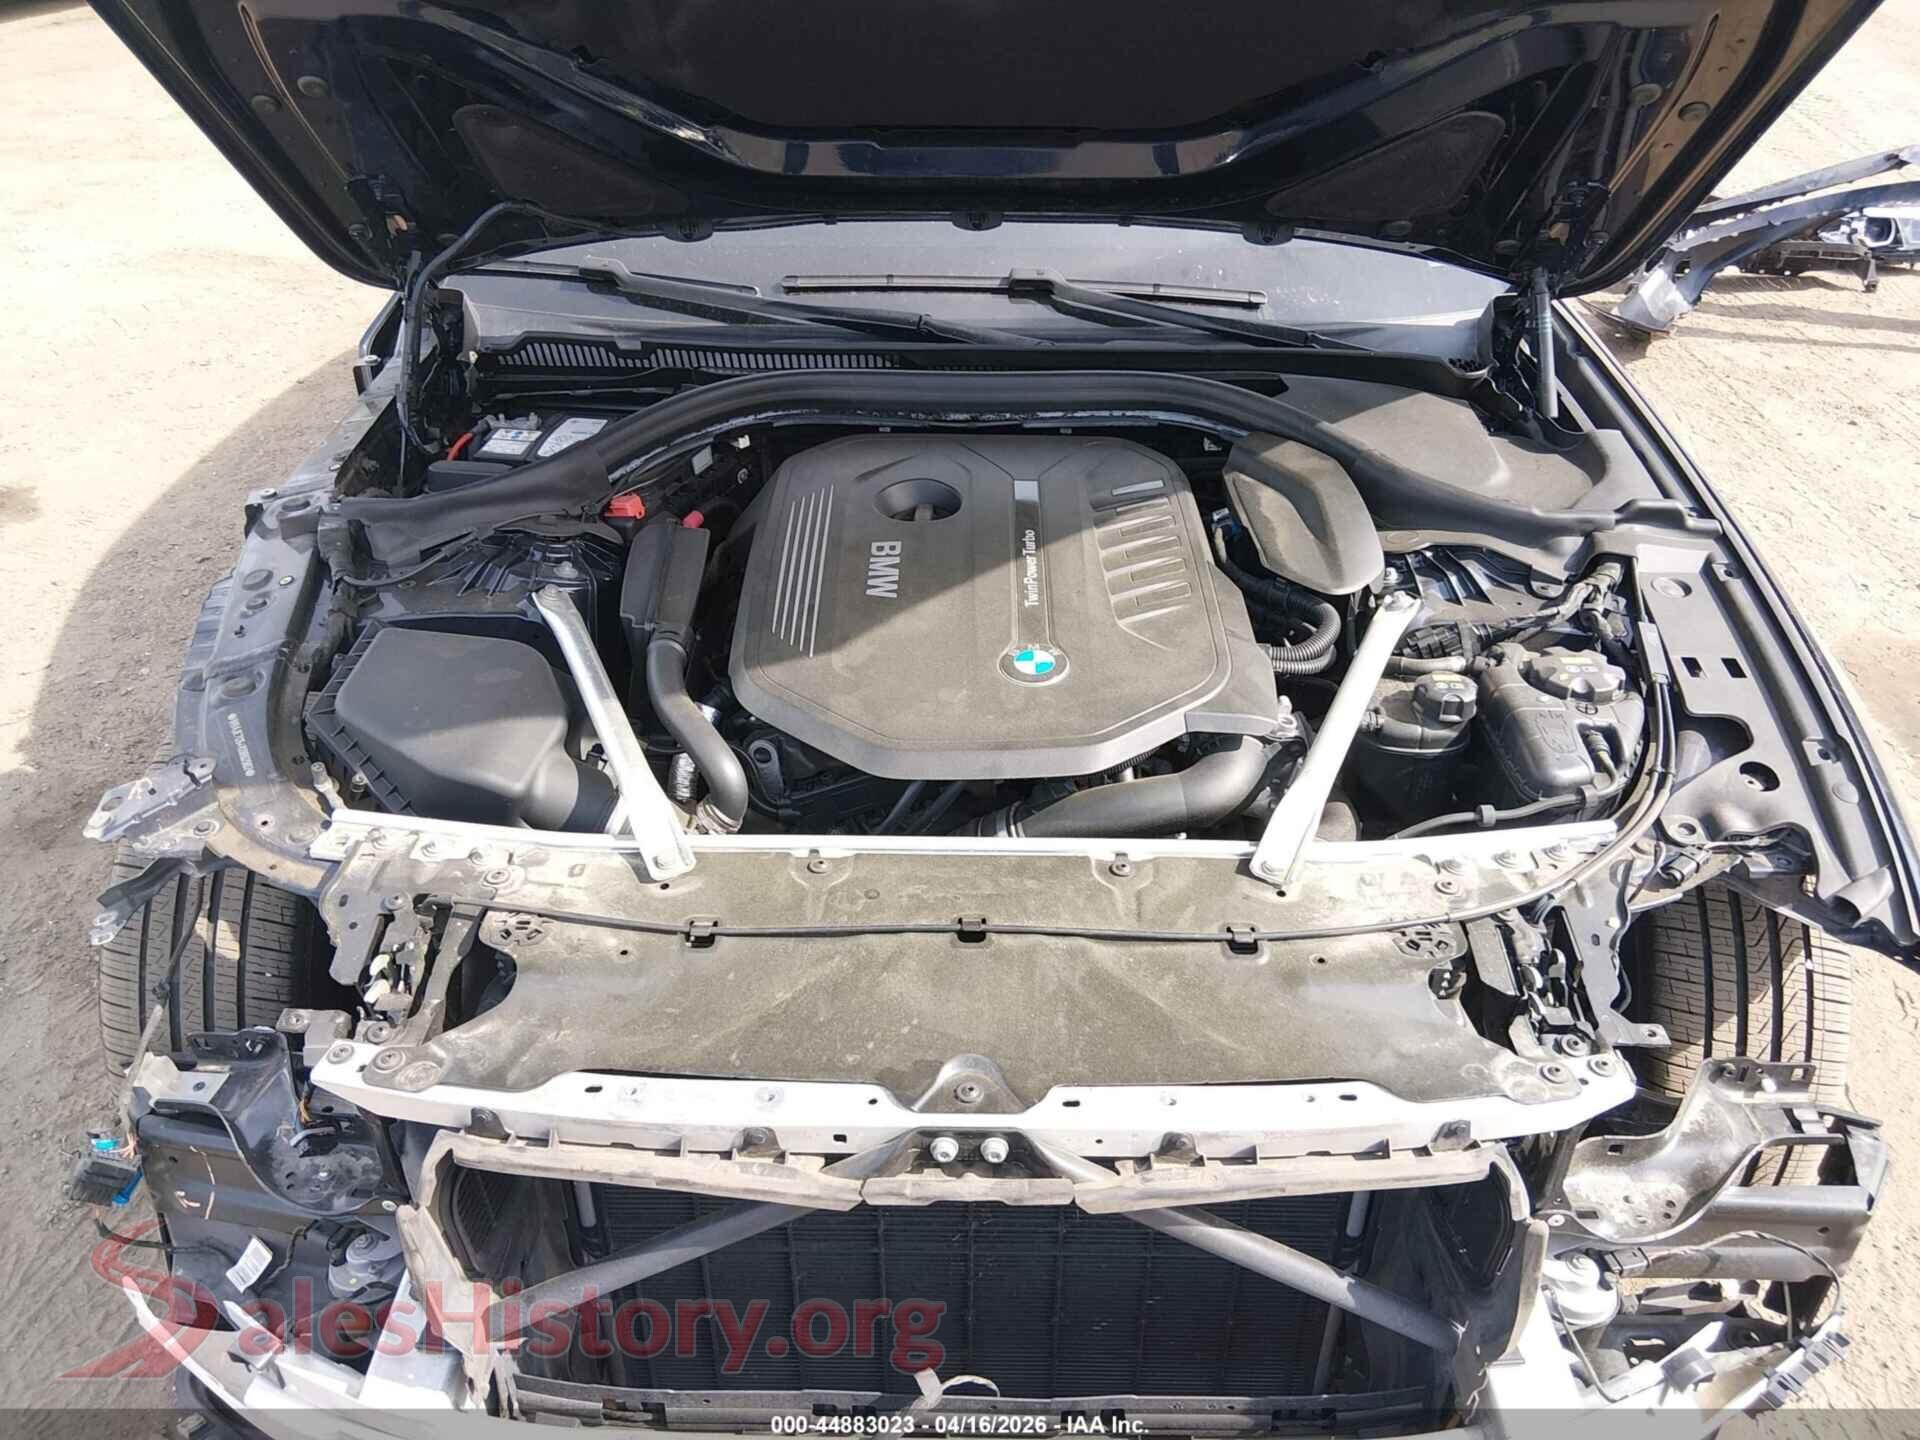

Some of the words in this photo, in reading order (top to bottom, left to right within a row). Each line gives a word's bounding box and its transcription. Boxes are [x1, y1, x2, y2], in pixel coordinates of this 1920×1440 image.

[1021, 529, 1036, 556] Turbo
[865, 541, 902, 599] BMW
[1023, 554, 1040, 608] TwinPower
